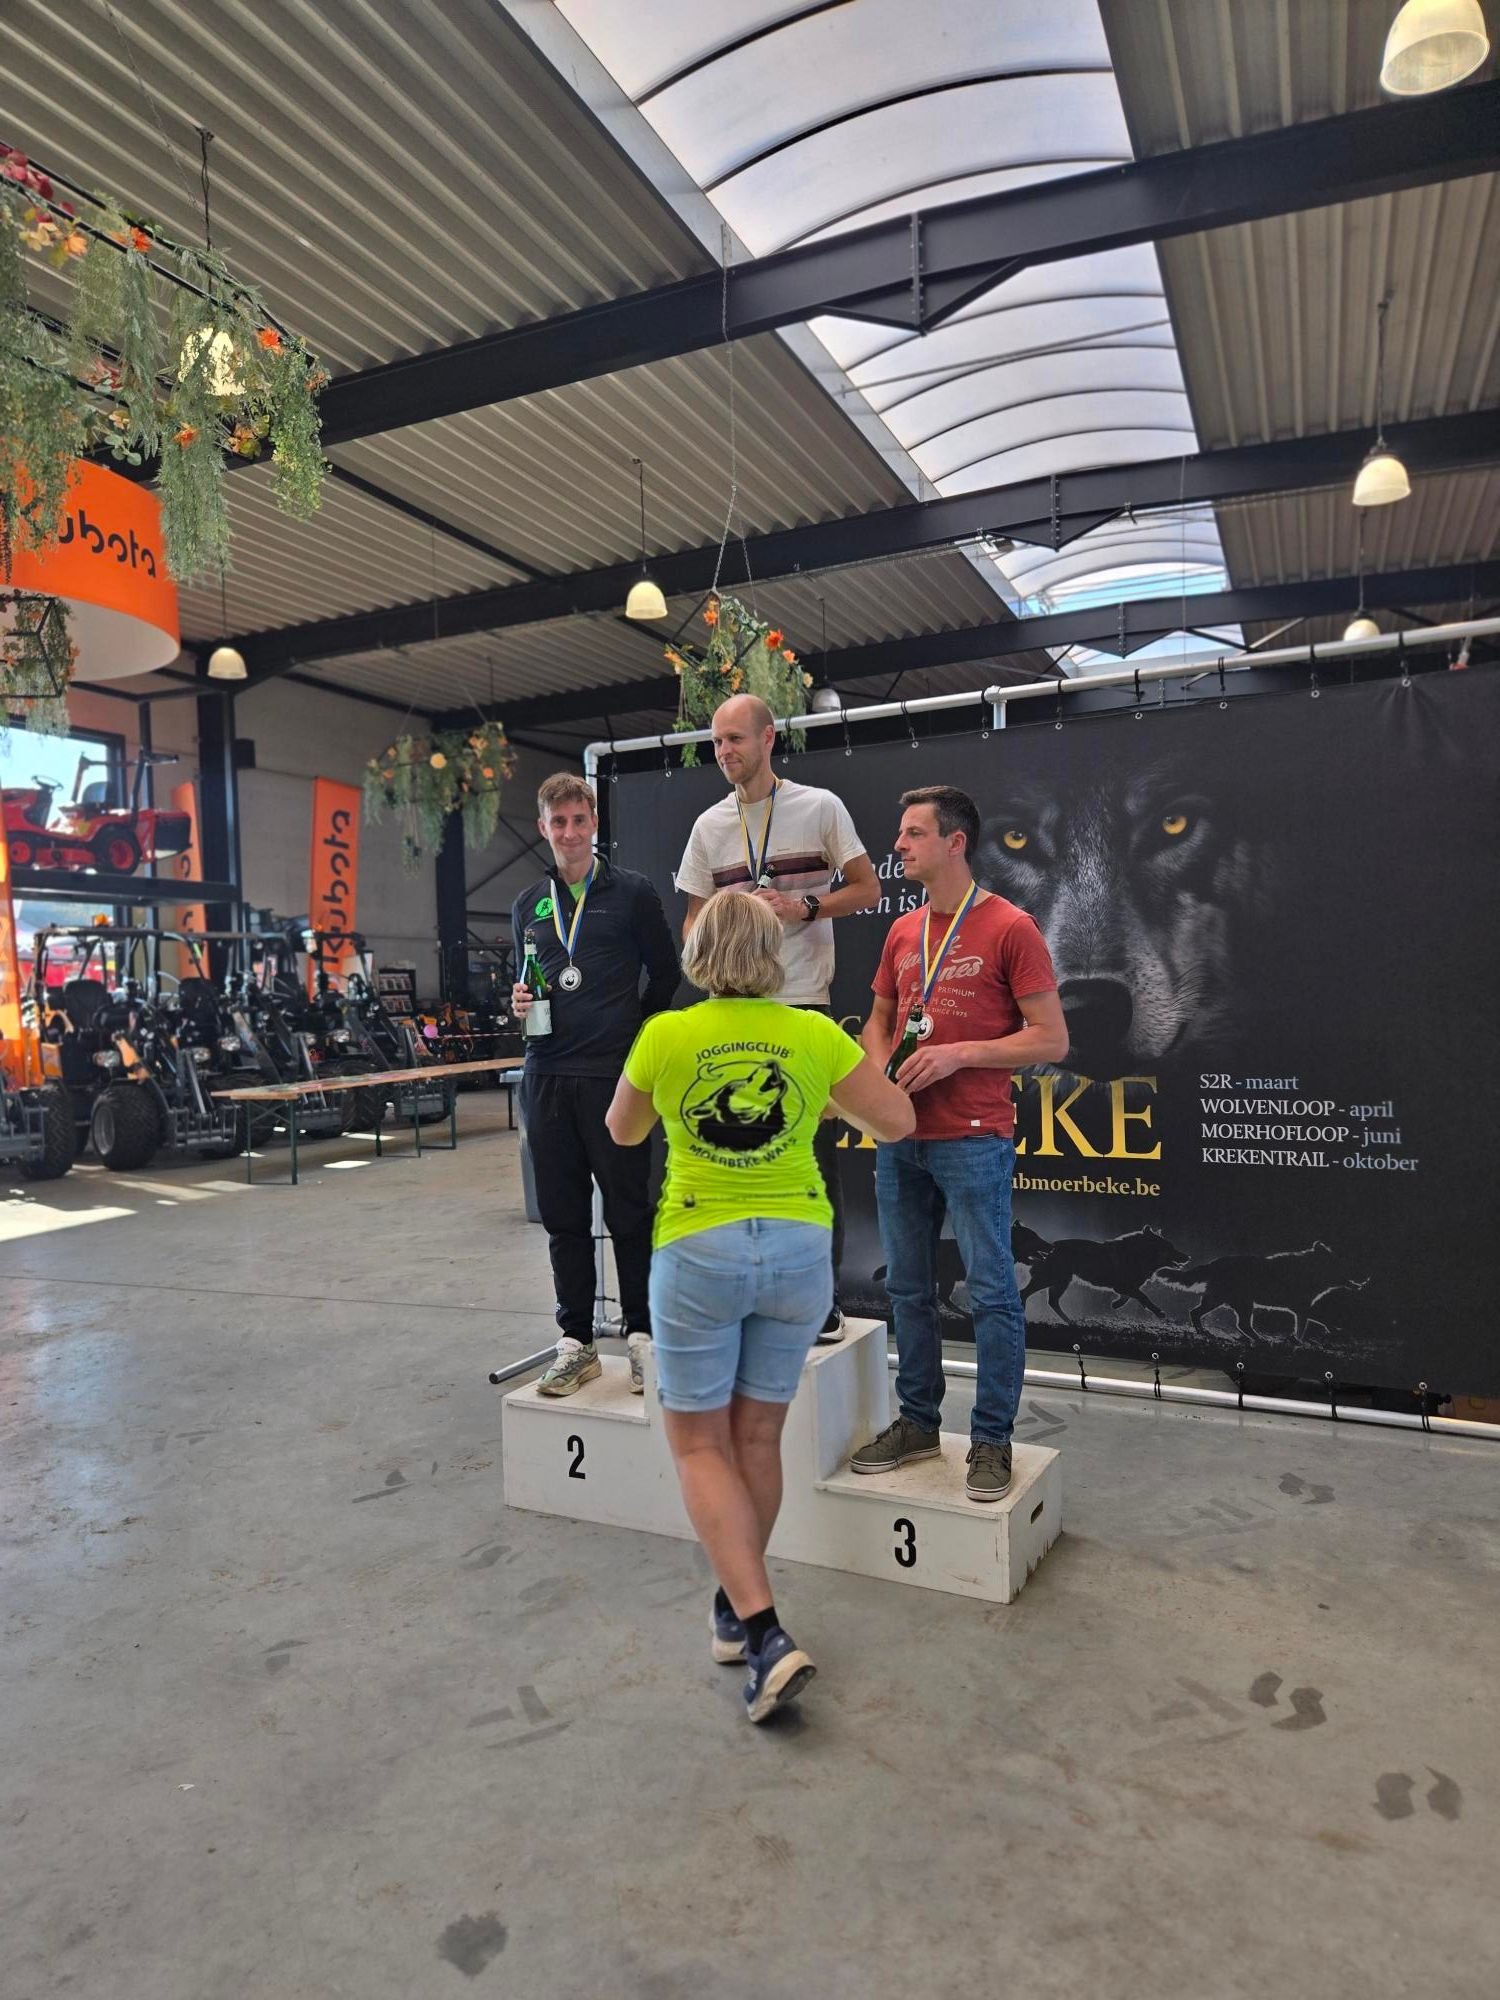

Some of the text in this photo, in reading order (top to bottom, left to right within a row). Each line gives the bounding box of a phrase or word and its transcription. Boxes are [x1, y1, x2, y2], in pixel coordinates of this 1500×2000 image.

[938, 986, 976, 998] PREMIUM
[696, 1041, 790, 1064] JOGGINGCLUB
[1200, 1073, 1233, 1090] S2R
[1245, 1076, 1300, 1091] maart
[1200, 1098, 1336, 1117] WOLVENLOOP
[1349, 1101, 1394, 1122] april
[1200, 1123, 1350, 1143] MOERHOFLOOP
[1361, 1126, 1402, 1148] juni
[1202, 1148, 1330, 1168] KREKENTRAIL
[1342, 1152, 1419, 1171] oktober
[567, 1434, 586, 1480] 2
[893, 1517, 917, 1568] 3
